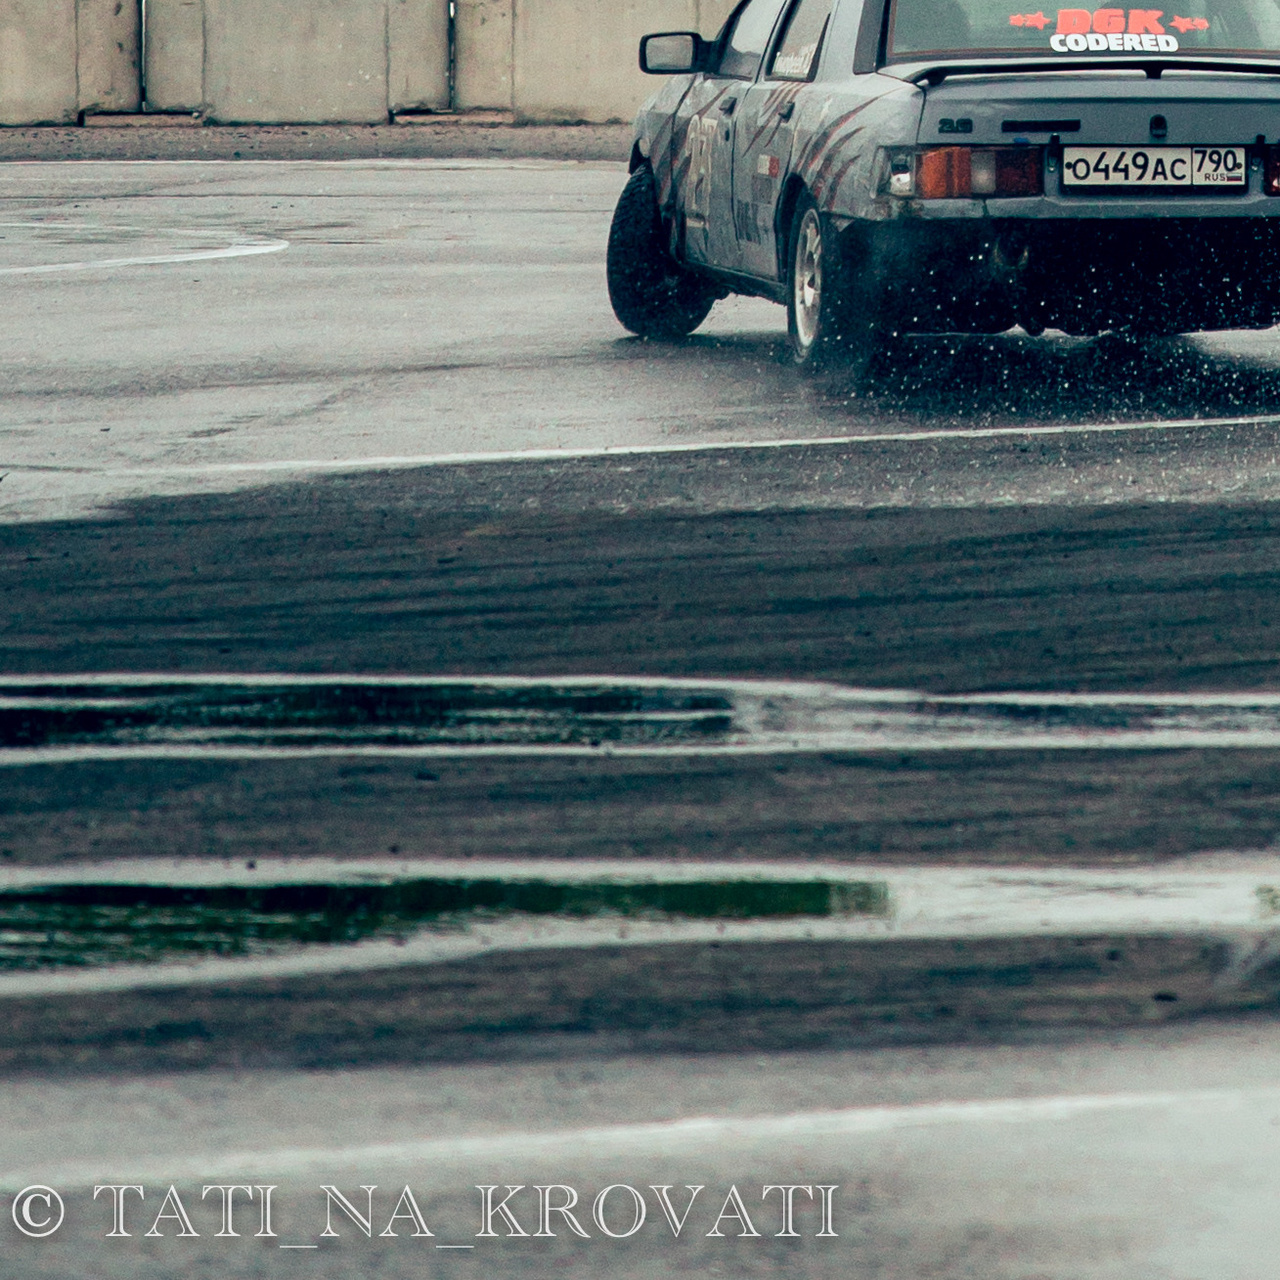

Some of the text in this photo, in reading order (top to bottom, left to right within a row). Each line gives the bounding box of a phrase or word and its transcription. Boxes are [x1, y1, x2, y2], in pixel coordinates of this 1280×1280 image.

[1056, 8, 1165, 34] DGK
[1049, 32, 1179, 52] CODERED
[1194, 149, 1238, 172] 790
[1204, 172, 1227, 182] RUS
